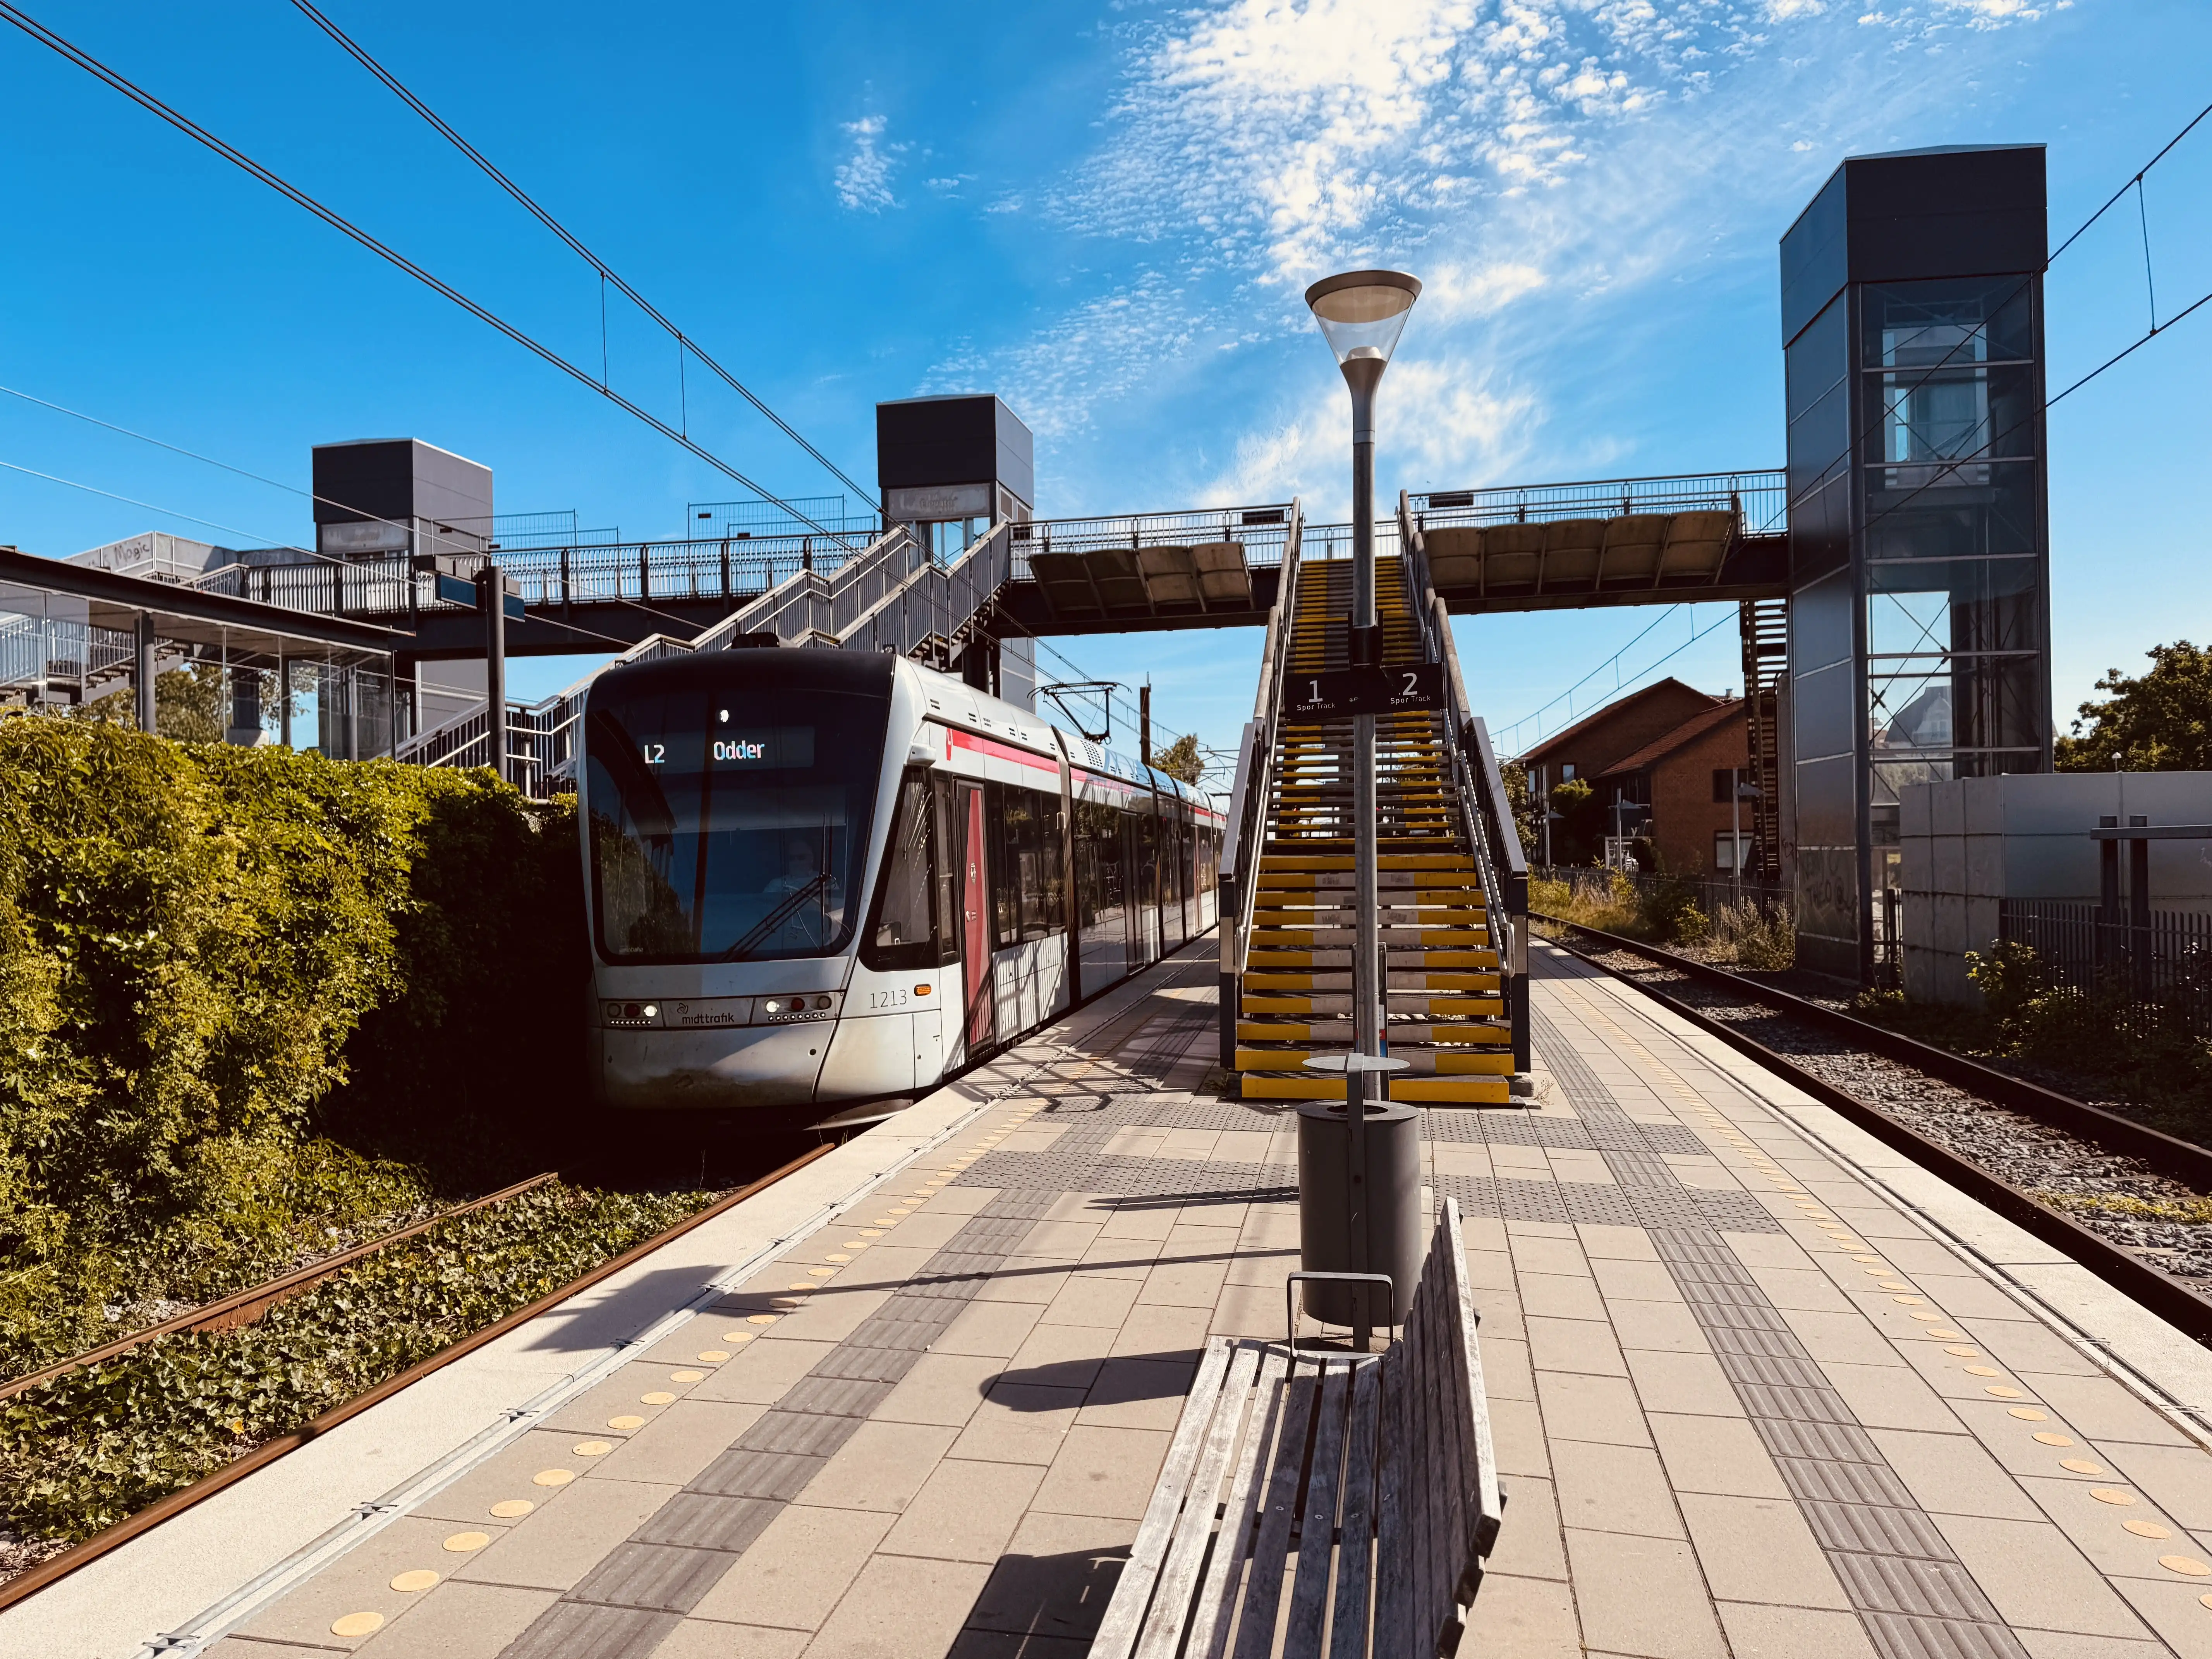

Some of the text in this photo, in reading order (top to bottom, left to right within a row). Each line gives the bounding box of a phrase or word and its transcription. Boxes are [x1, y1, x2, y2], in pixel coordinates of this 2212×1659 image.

[1309, 680, 1323, 703] 1
[1402, 672, 1418, 696] 2
[644, 740, 765, 764] L2 Odder
[870, 989, 907, 1009] 1213
[682, 1012, 735, 1025] midttrafik
